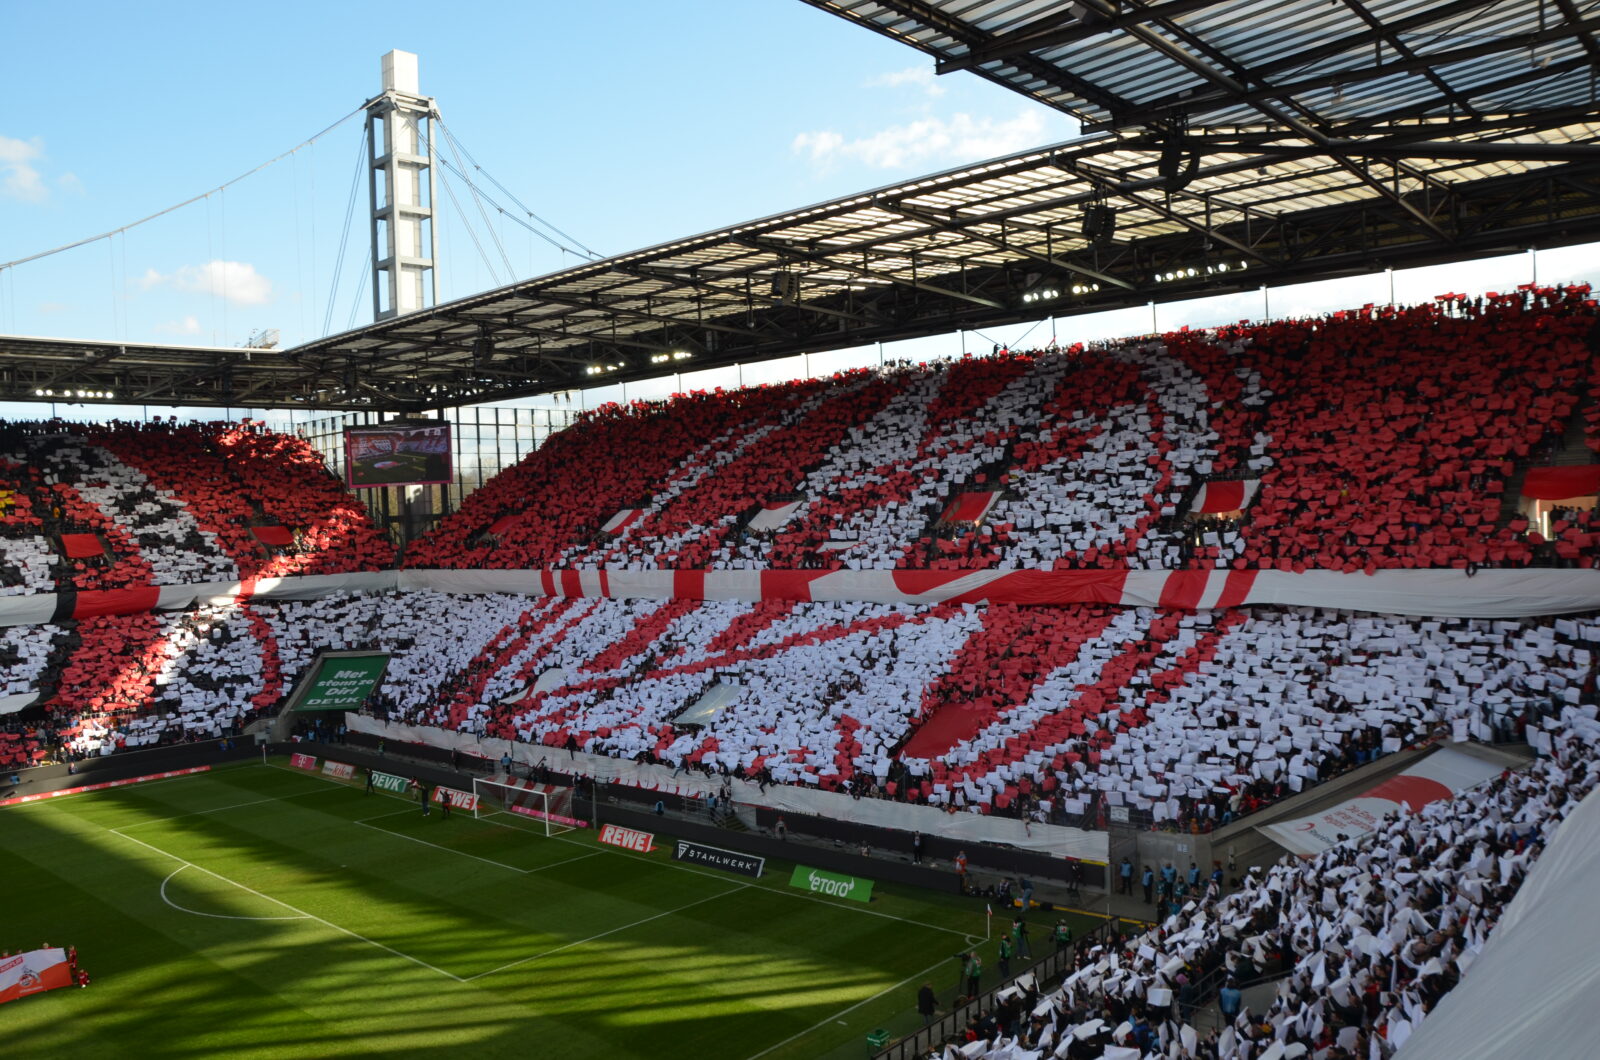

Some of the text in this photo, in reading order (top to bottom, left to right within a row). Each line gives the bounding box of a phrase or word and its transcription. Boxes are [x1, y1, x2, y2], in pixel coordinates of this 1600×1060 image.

[334, 670, 368, 679] Mer
[325, 687, 359, 696] Dir!
[306, 697, 359, 705] DEVK
[602, 826, 647, 851] REWE
[688, 850, 752, 870] STAHLWERK
